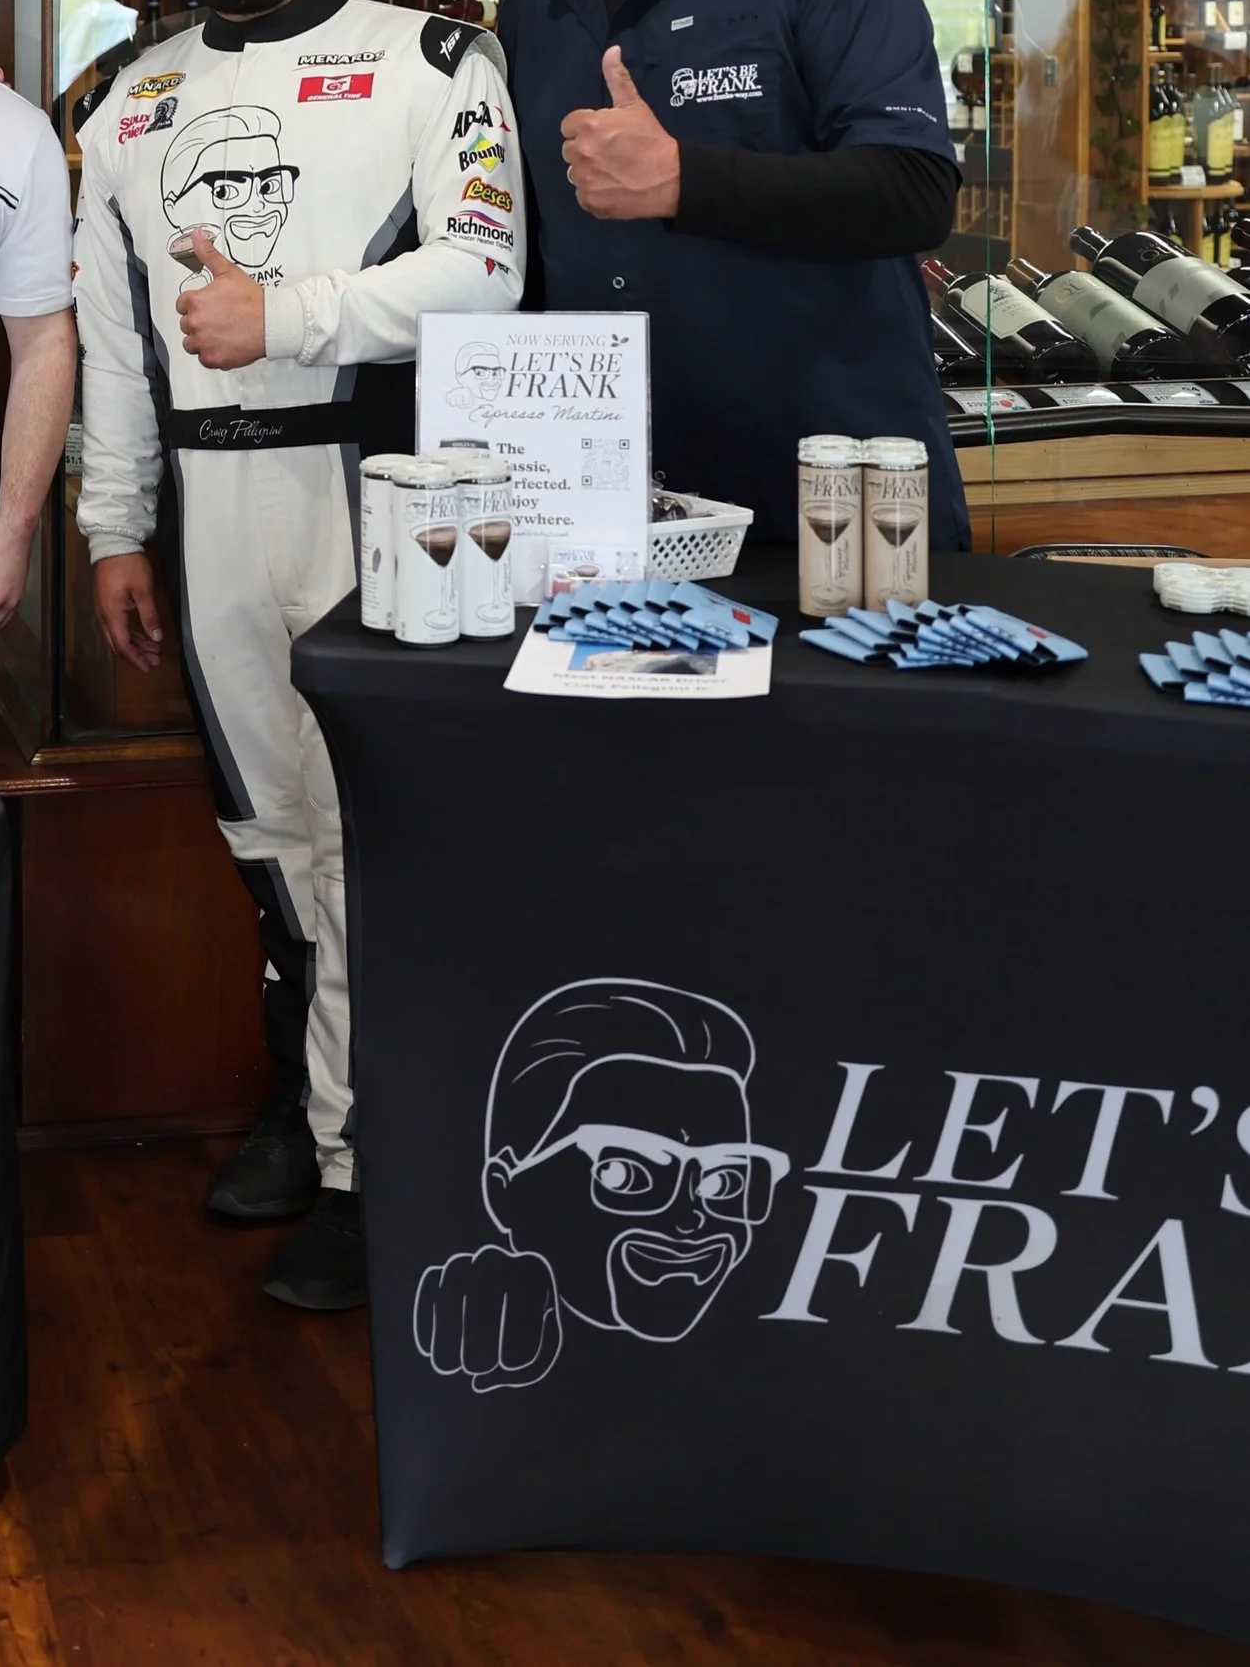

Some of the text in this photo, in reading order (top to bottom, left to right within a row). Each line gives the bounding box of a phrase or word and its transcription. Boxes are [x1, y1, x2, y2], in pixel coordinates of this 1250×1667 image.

[297, 50, 385, 65] MENARDS
[697, 63, 758, 83] LET'S BE
[127, 73, 186, 97] MENARDS
[119, 114, 152, 131] Sioux
[458, 142, 506, 173] Bounty
[466, 179, 514, 211] Reese's
[446, 217, 514, 248] Richmond
[506, 334, 606, 347] NOW SERVING
[510, 352, 623, 373] LET'S BE
[506, 372, 622, 399] FRANK
[468, 404, 625, 429] Espresso Martini
[496, 443, 526, 455] The
[505, 460, 551, 474] assic,
[513, 477, 572, 491] rfected.
[482, 499, 510, 514] FRA
[512, 495, 540, 510] njoy
[429, 506, 456, 519] FRA
[513, 514, 575, 529] ywhere.
[758, 1184, 1250, 1377] FRA
